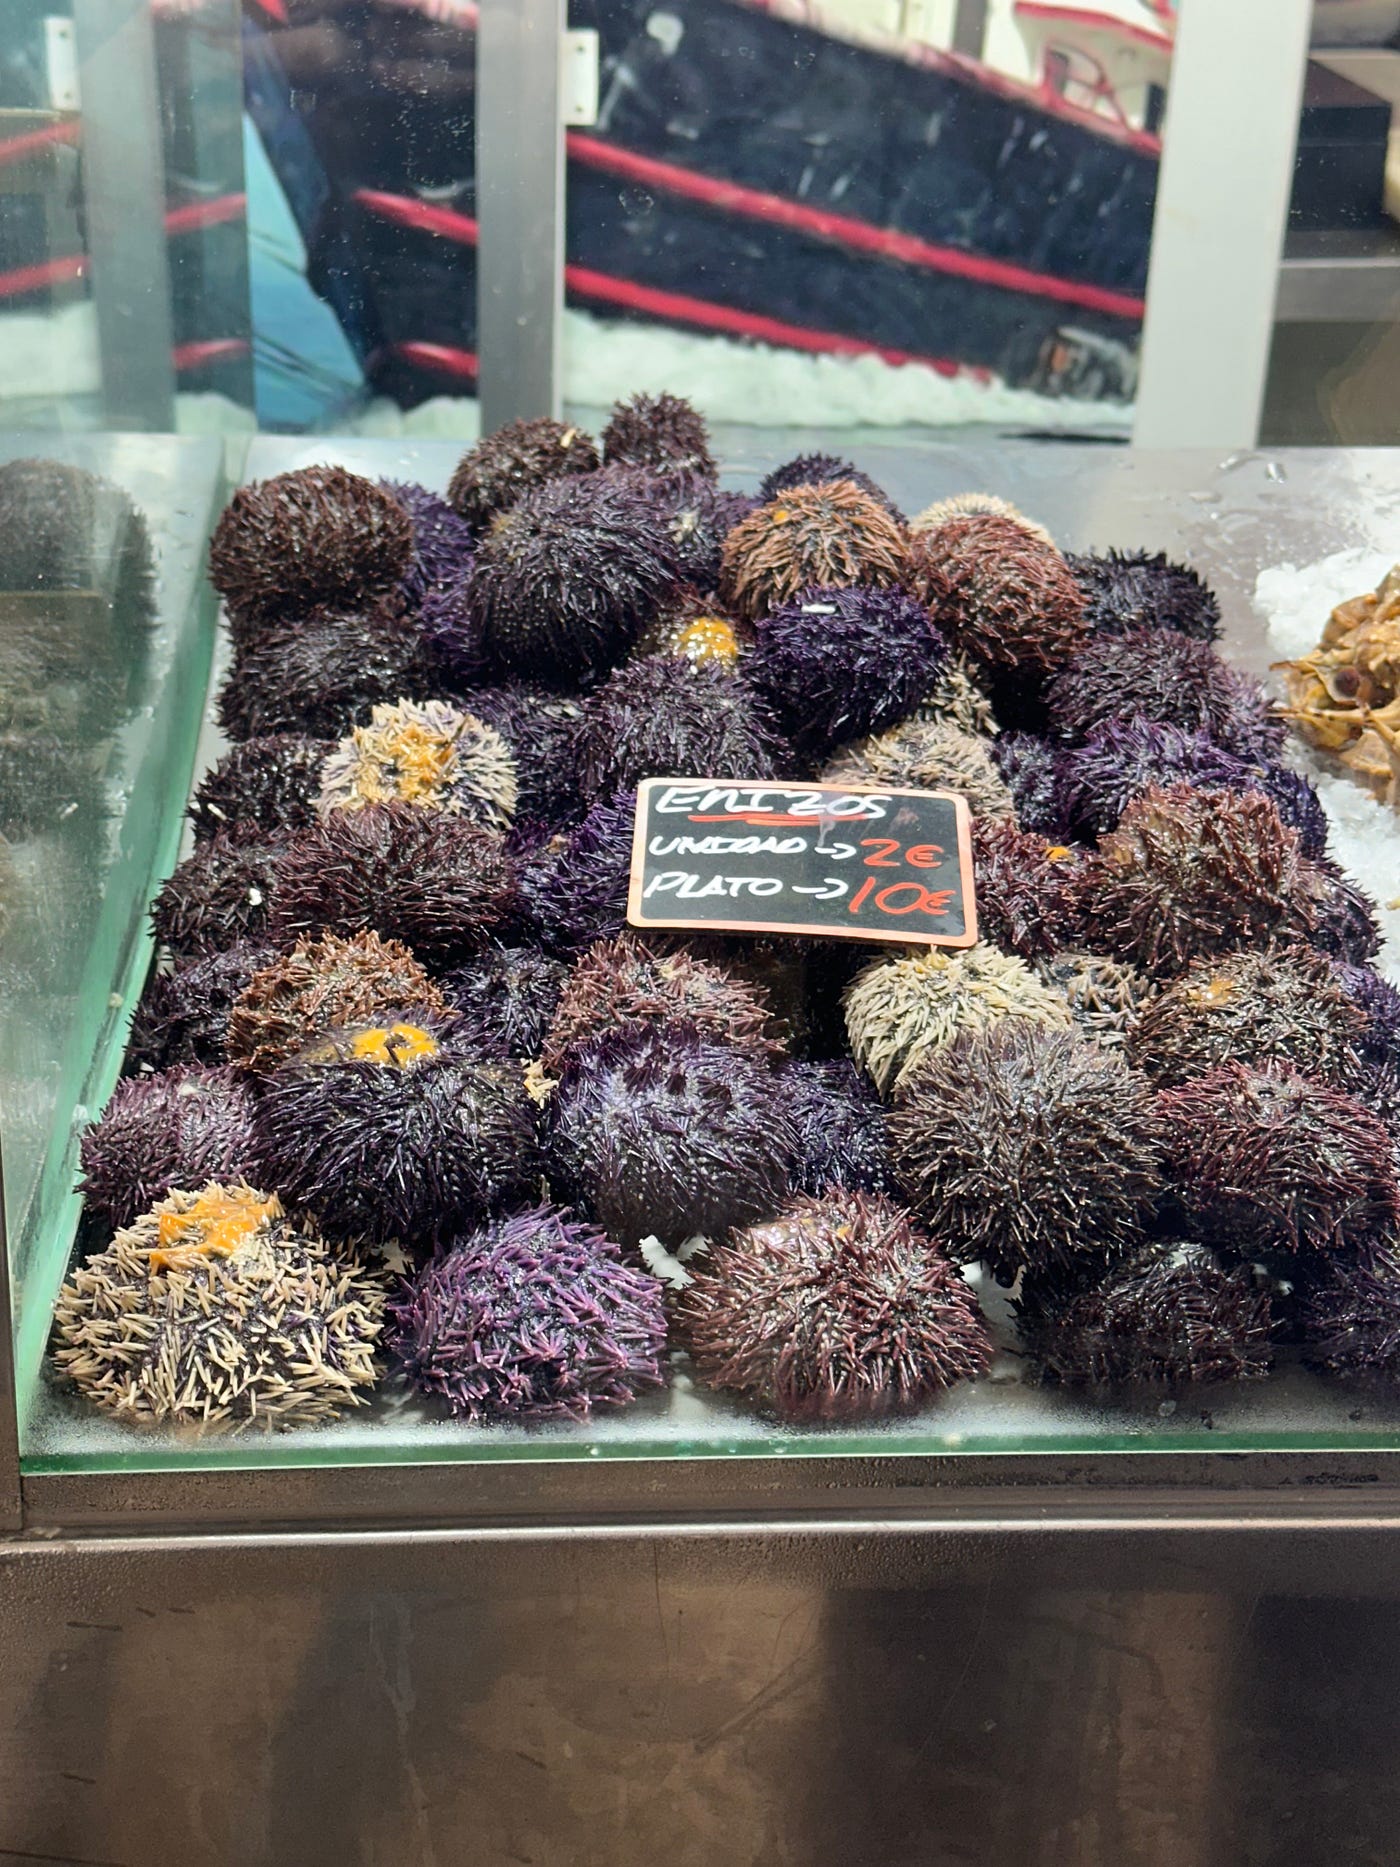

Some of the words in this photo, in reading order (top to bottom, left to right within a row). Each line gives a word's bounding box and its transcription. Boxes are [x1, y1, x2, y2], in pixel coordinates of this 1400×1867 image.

[860, 838, 944, 868] 2€
[642, 871, 783, 898] PLATO
[848, 876, 956, 915] 10€
